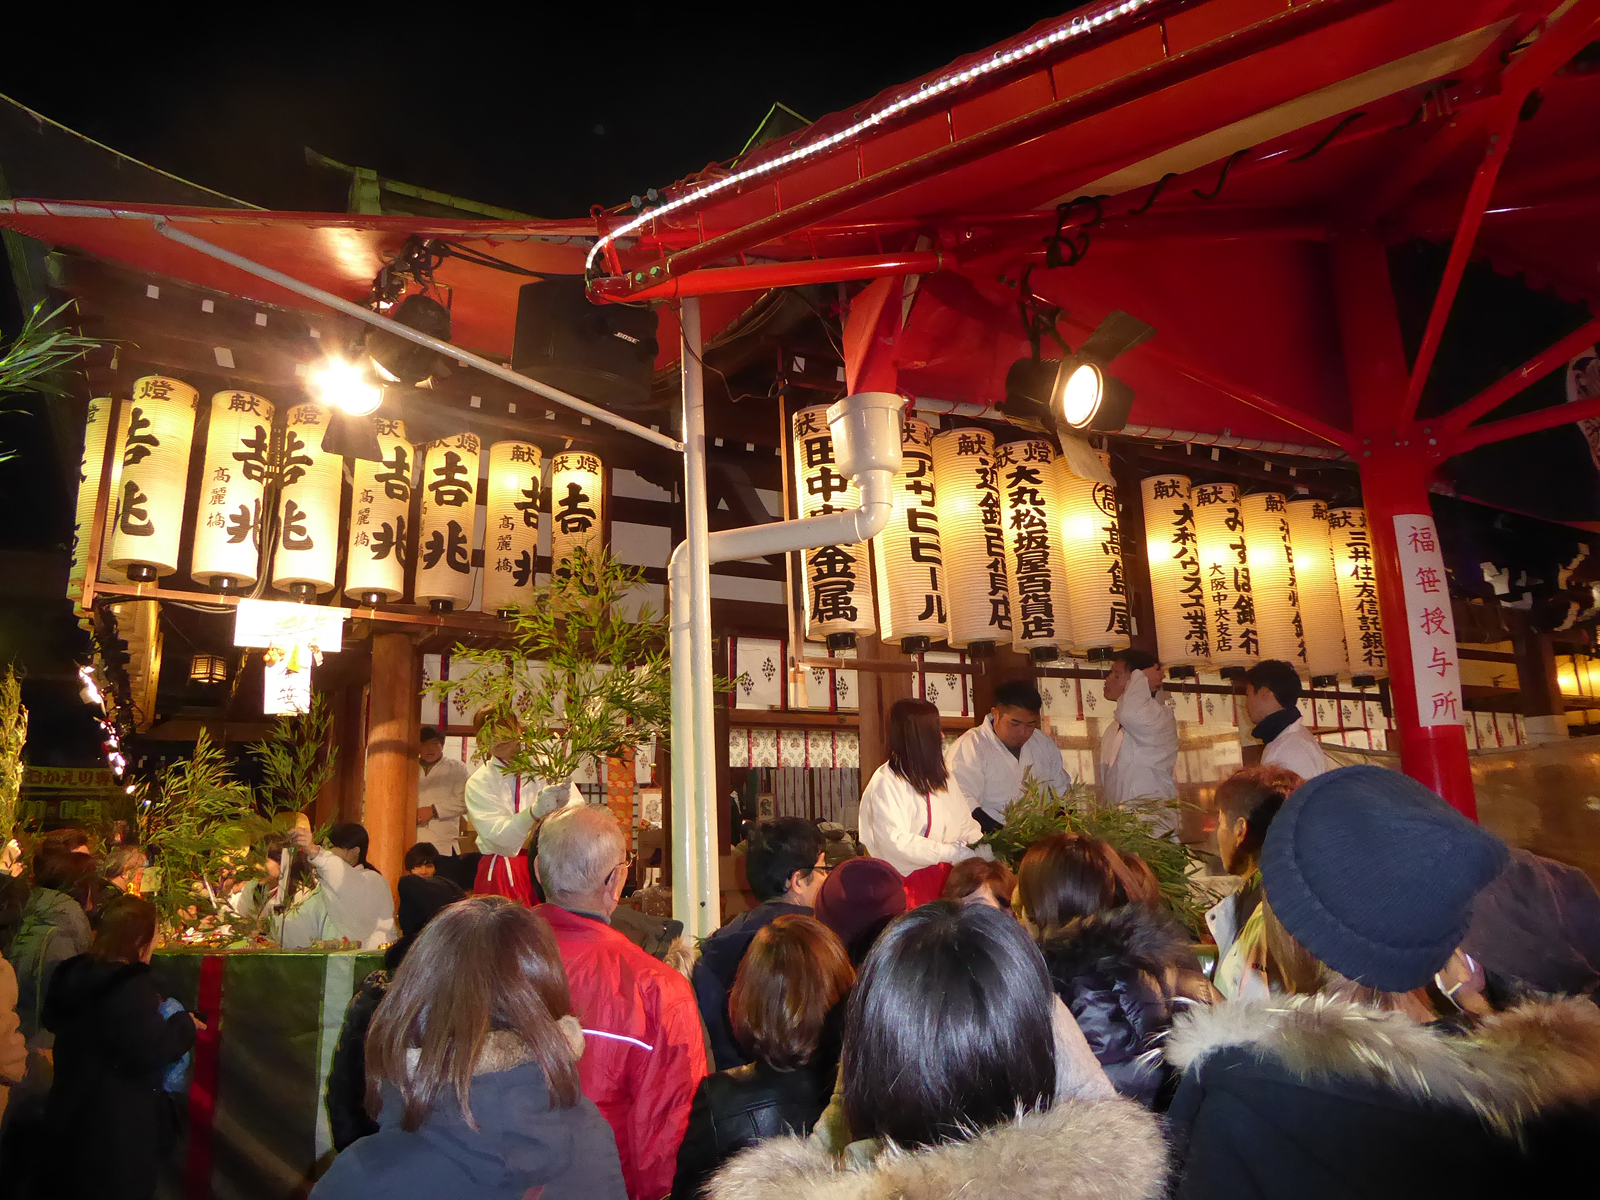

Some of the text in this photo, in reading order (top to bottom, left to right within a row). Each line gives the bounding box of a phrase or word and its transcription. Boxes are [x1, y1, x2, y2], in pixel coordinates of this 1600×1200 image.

[613, 331, 640, 345] BOSE
[794, 411, 832, 443] 献
[422, 450, 473, 574] 吉兆
[804, 434, 860, 624] 田中金属
[1153, 479, 1192, 500] 献
[1005, 465, 1055, 640] 大丸松坂屋百貨店
[1208, 562, 1233, 652] 大阪中央支店
[1345, 530, 1387, 667] 三井住友信託銀行
[1407, 525, 1458, 721] 福笹授与所
